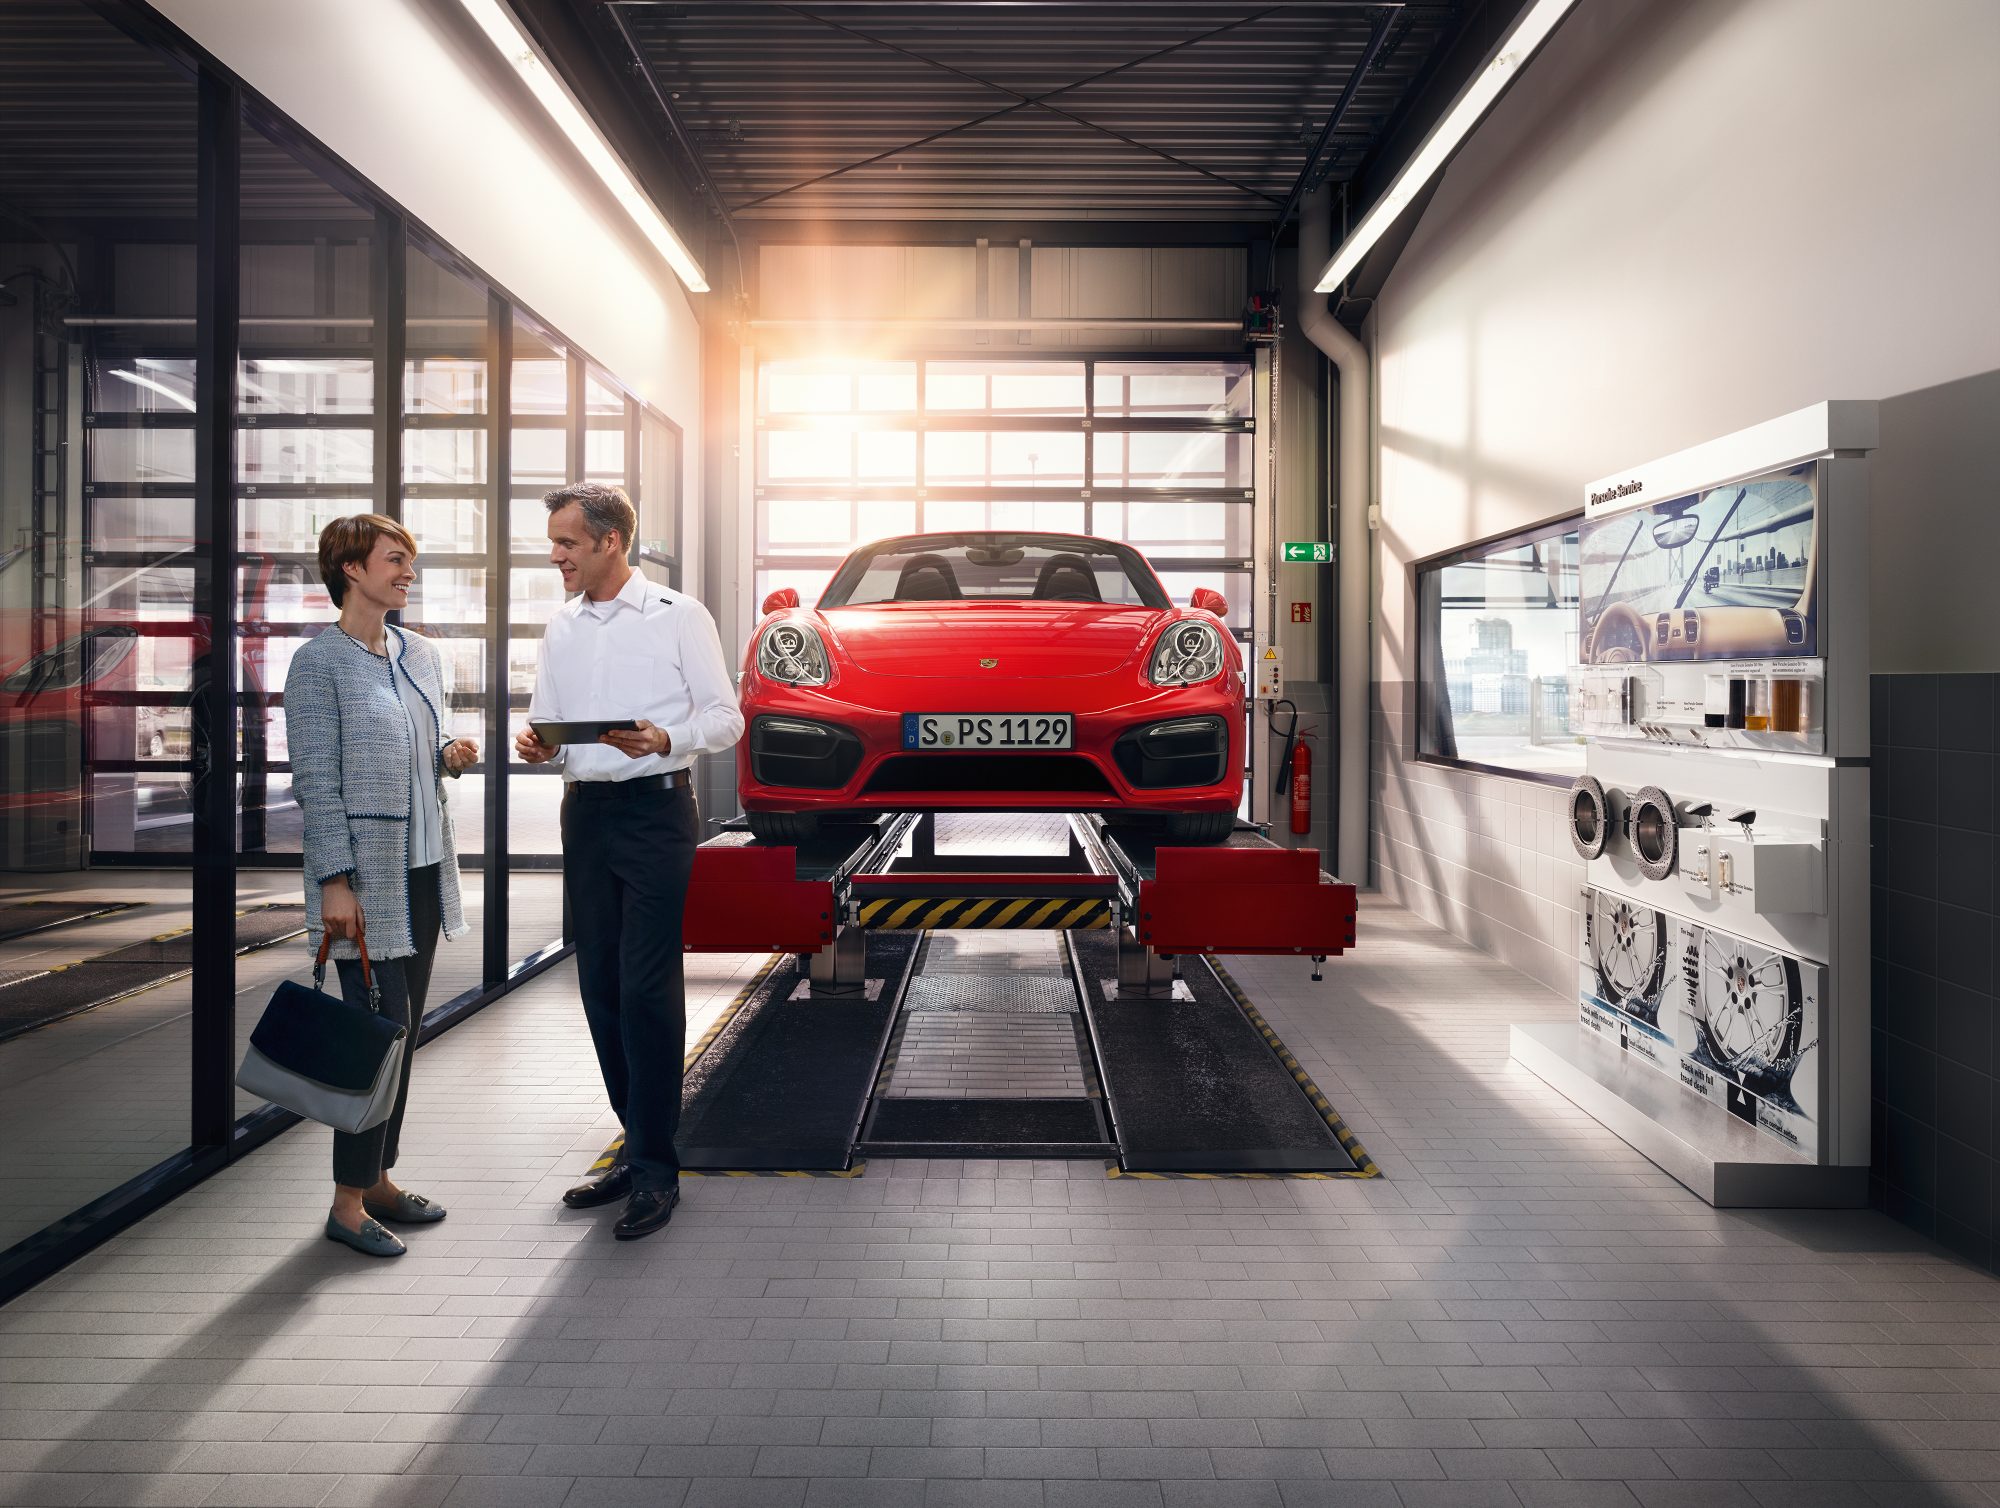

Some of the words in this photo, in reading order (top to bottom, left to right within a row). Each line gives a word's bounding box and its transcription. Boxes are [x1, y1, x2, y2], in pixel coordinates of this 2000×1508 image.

[1591, 488, 1617, 506] Porsche
[1617, 480, 1642, 497] Service
[908, 735, 914, 743] D
[921, 718, 938, 745] S
[958, 718, 993, 745] PS
[999, 718, 1068, 745] 1129
[1580, 1014, 1591, 1026] tread
[1590, 1008, 1599, 1020] with
[1680, 1058, 1694, 1074] Track
[1694, 1067, 1705, 1081] with
[1705, 1073, 1714, 1086] full
[1680, 1072, 1693, 1087] tread
[1693, 1079, 1708, 1096] depth
[1768, 1120, 1783, 1133] contact
